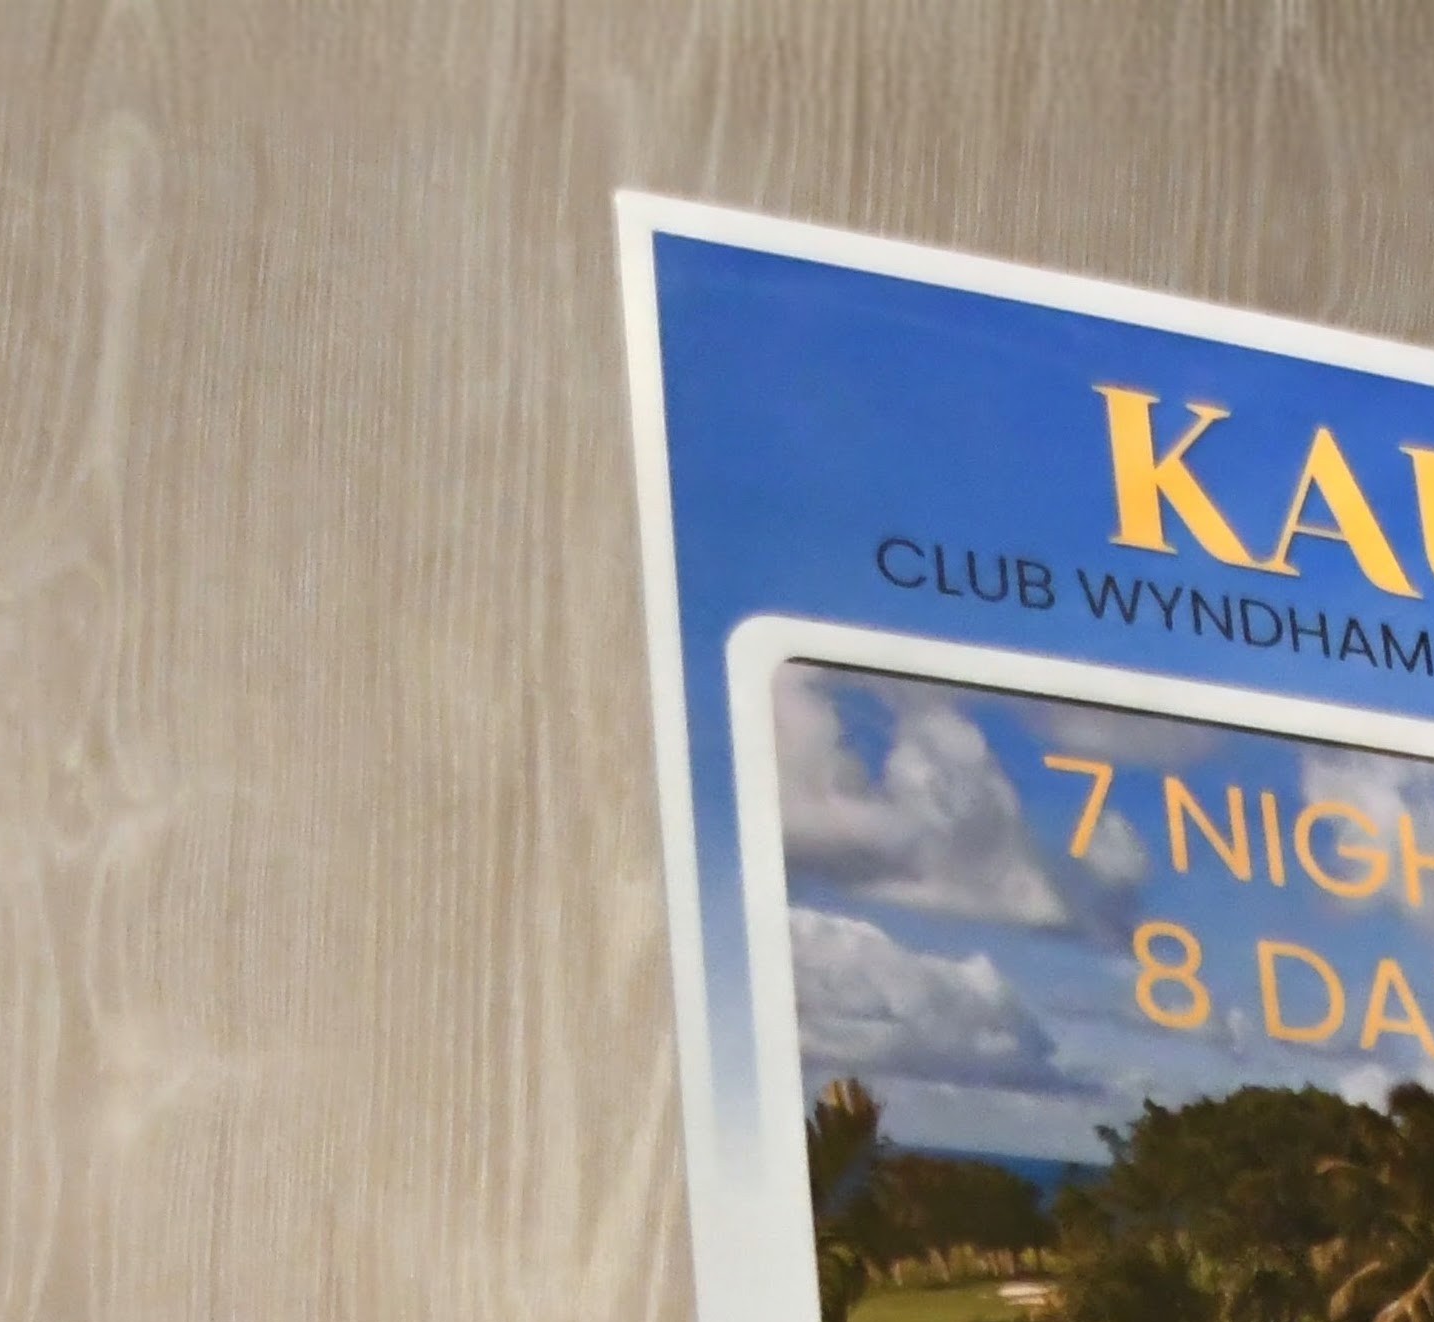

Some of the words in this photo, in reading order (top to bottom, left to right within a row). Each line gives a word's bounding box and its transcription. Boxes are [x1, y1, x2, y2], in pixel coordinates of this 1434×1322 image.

[876, 537, 1056, 610] CLUB
[1076, 568, 1434, 677] WYNDHAM
[1043, 754, 1114, 859] 7
[1132, 921, 1211, 1031] 8
